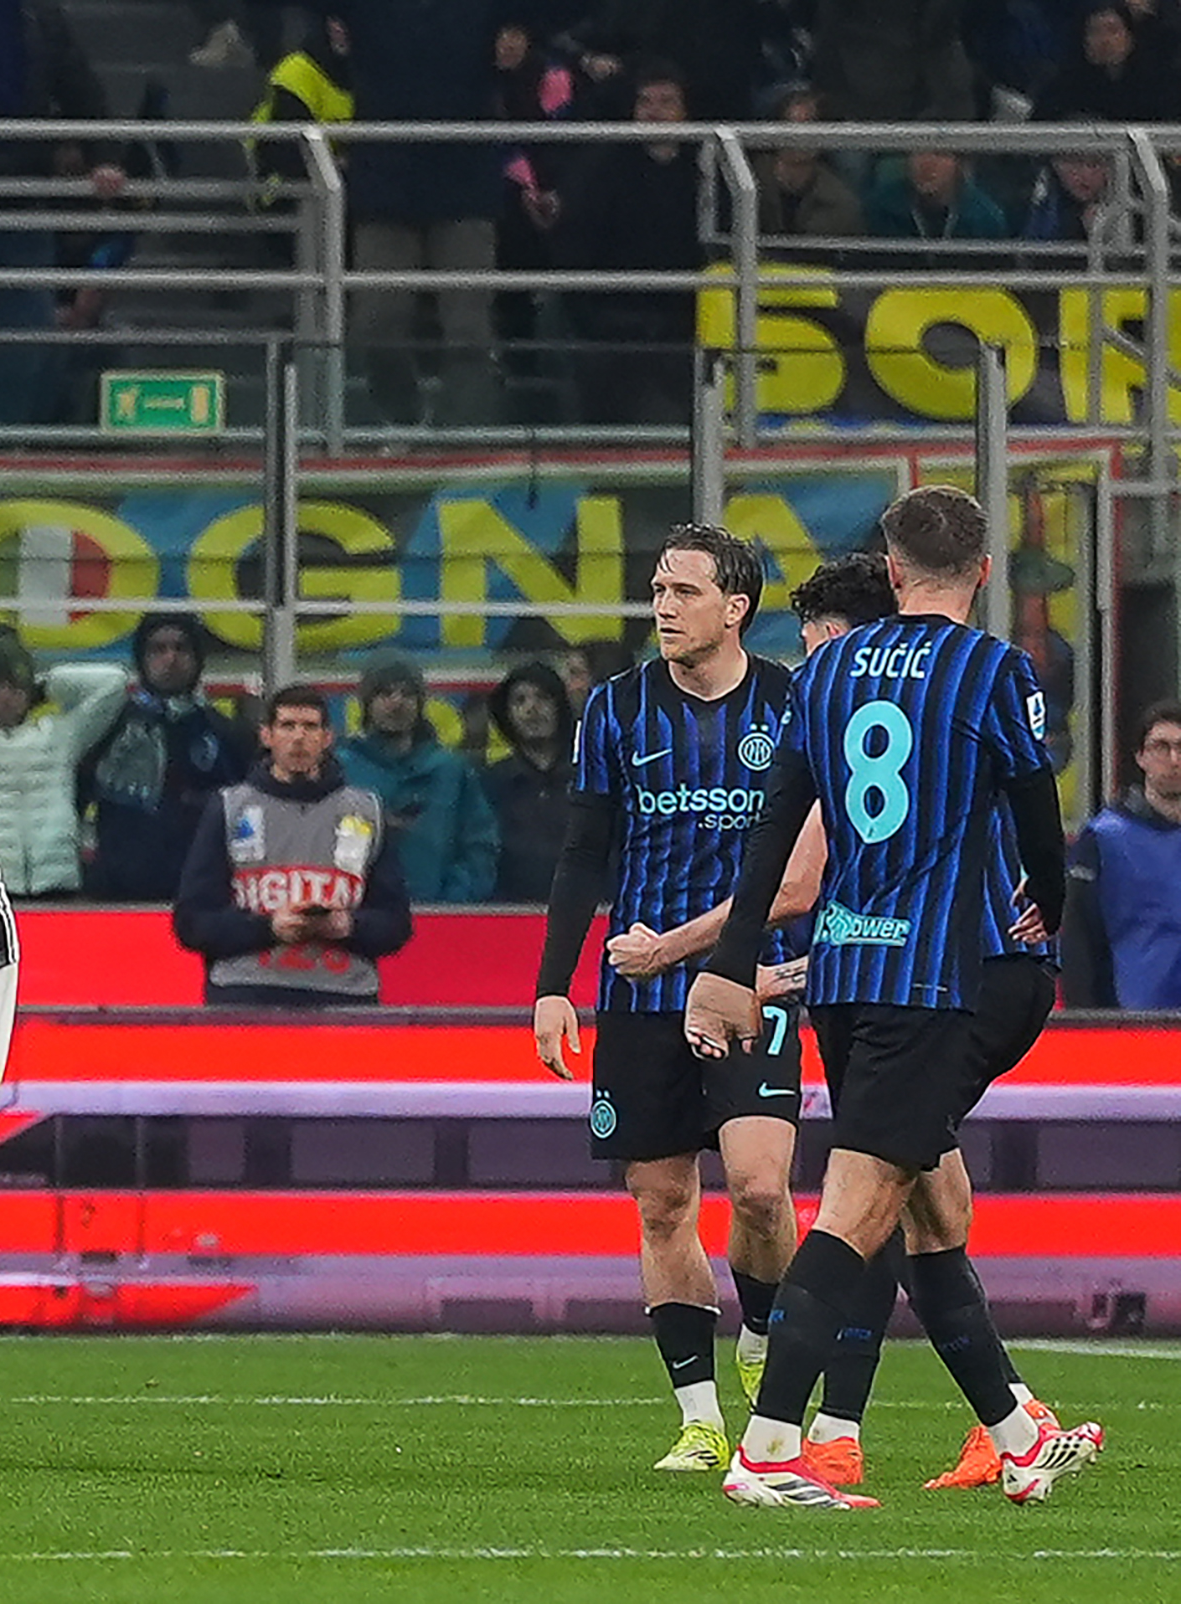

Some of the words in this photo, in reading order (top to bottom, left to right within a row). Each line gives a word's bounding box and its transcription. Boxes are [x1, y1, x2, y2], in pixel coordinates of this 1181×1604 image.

[850, 641, 932, 679] SUČIĆ
[843, 700, 913, 844] 8
[635, 782, 765, 815] betsson
[762, 1005, 788, 1056] 7
